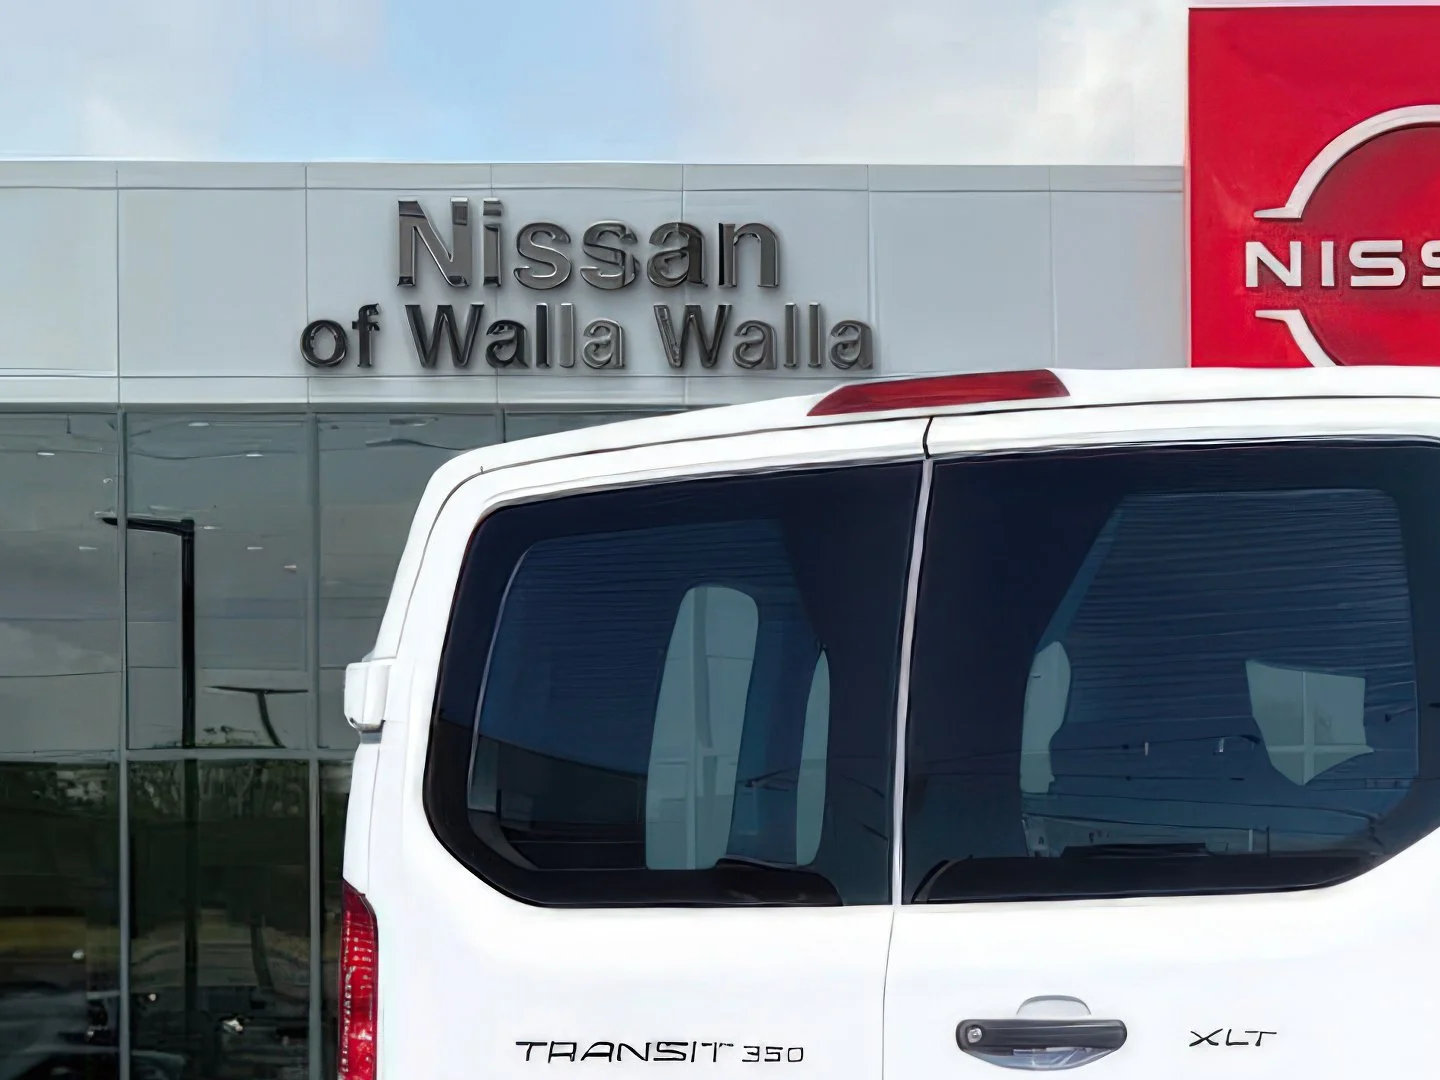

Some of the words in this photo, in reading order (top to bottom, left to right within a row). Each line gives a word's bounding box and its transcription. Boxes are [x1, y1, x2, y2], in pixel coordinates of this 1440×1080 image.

[397, 197, 781, 289] Nissan
[300, 303, 380, 370] of
[404, 303, 626, 370] Walla
[653, 303, 875, 370] Walla
[515, 1041, 735, 1063] TRANSIT
[741, 1045, 804, 1063] 350
[1189, 1028, 1277, 1047] XLT
